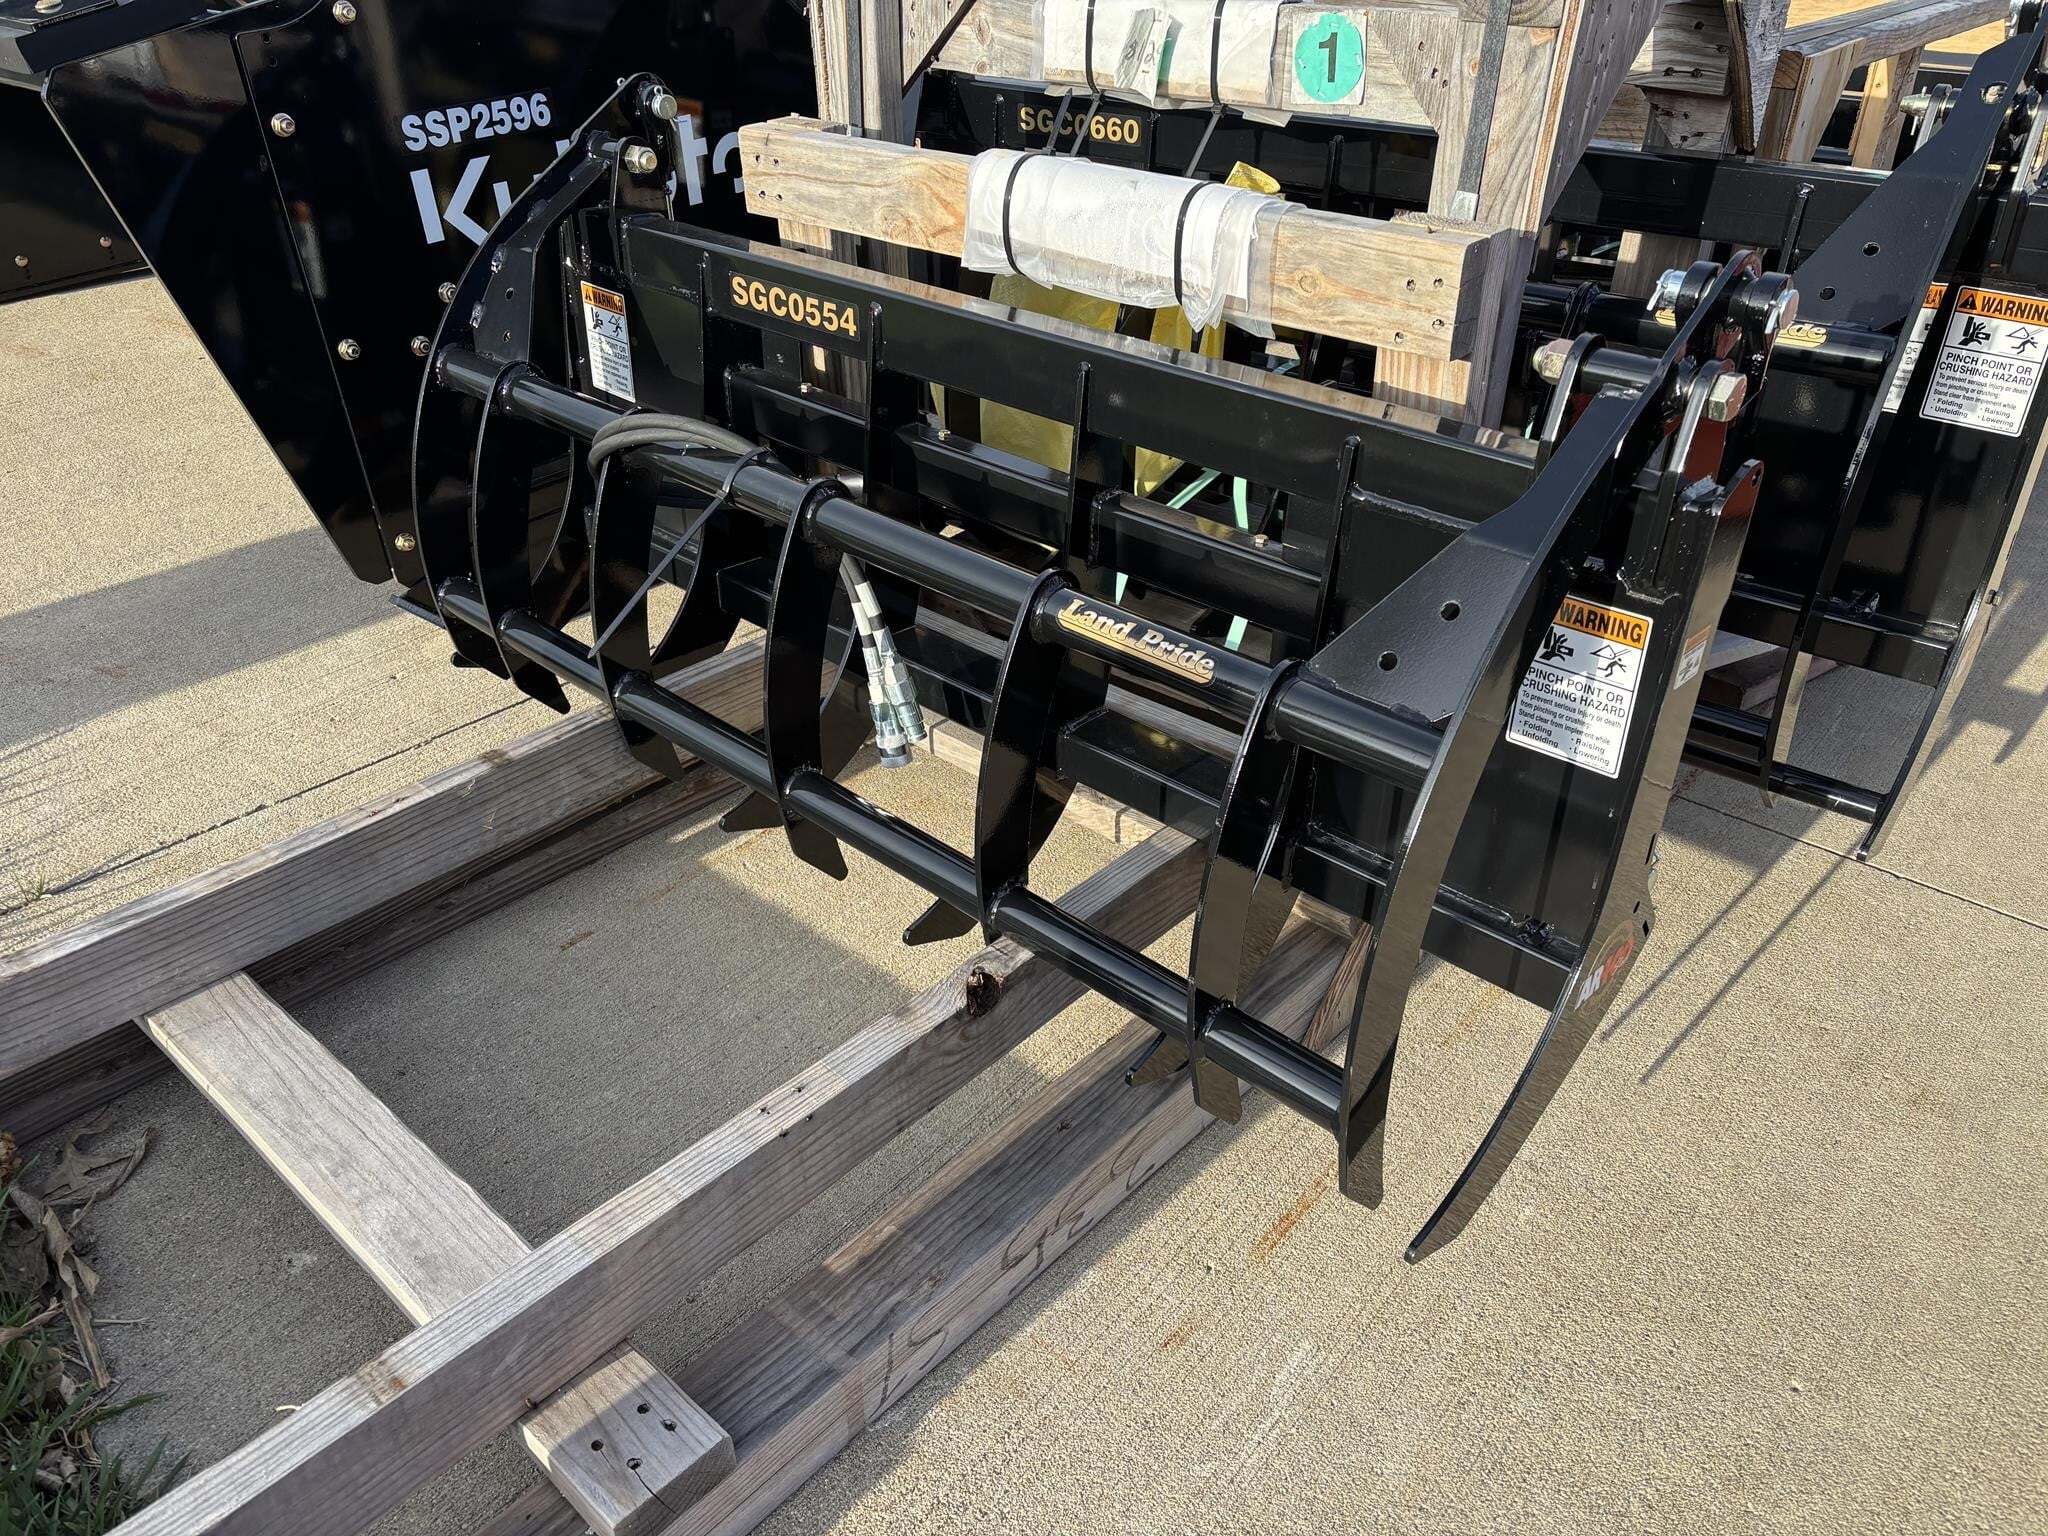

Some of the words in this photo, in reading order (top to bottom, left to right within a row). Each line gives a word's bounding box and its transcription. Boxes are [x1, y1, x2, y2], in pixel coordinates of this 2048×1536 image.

[1317, 31, 1339, 84] 1
[401, 92, 551, 152] SSP2596
[731, 276, 858, 337] SGC0554
[1940, 361, 1989, 378] CRUSHING
[1992, 371, 2033, 386] HAZARD
[1946, 352, 1979, 366] PINCH
[1981, 359, 2014, 372] POINT
[2016, 365, 2032, 376] OR
[1946, 375, 1967, 384] prevent
[1967, 379, 1987, 387] serious
[1948, 383, 1969, 394] pinching
[1934, 406, 1968, 418] Unfolding
[1937, 398, 1963, 409] Folding
[1984, 407, 2011, 418] Raising
[1981, 415, 2014, 427] Lowering
[1559, 601, 1643, 644] WARNING
[1061, 598, 1136, 641] Land
[1134, 629, 1216, 675] Pride
[1528, 666, 1564, 685] PINCH
[1567, 679, 1603, 698] POINT
[1606, 691, 1623, 705] OR
[1521, 677, 1577, 703] CRUSHING
[1579, 695, 1626, 718] HAZARD
[1530, 693, 1553, 706] prevent
[1554, 700, 1576, 713] serious
[1577, 707, 1595, 721] injury
[1518, 708, 1534, 720] Stand
[1535, 714, 1549, 724] clear
[1550, 718, 1563, 729] from
[1520, 700, 1532, 710] from
[1533, 703, 1558, 718] pinching
[1522, 728, 1559, 748] Unfolding
[1523, 720, 1552, 737] Folding
[1573, 747, 1610, 766] Lowering
[1575, 738, 1605, 755] Raising
